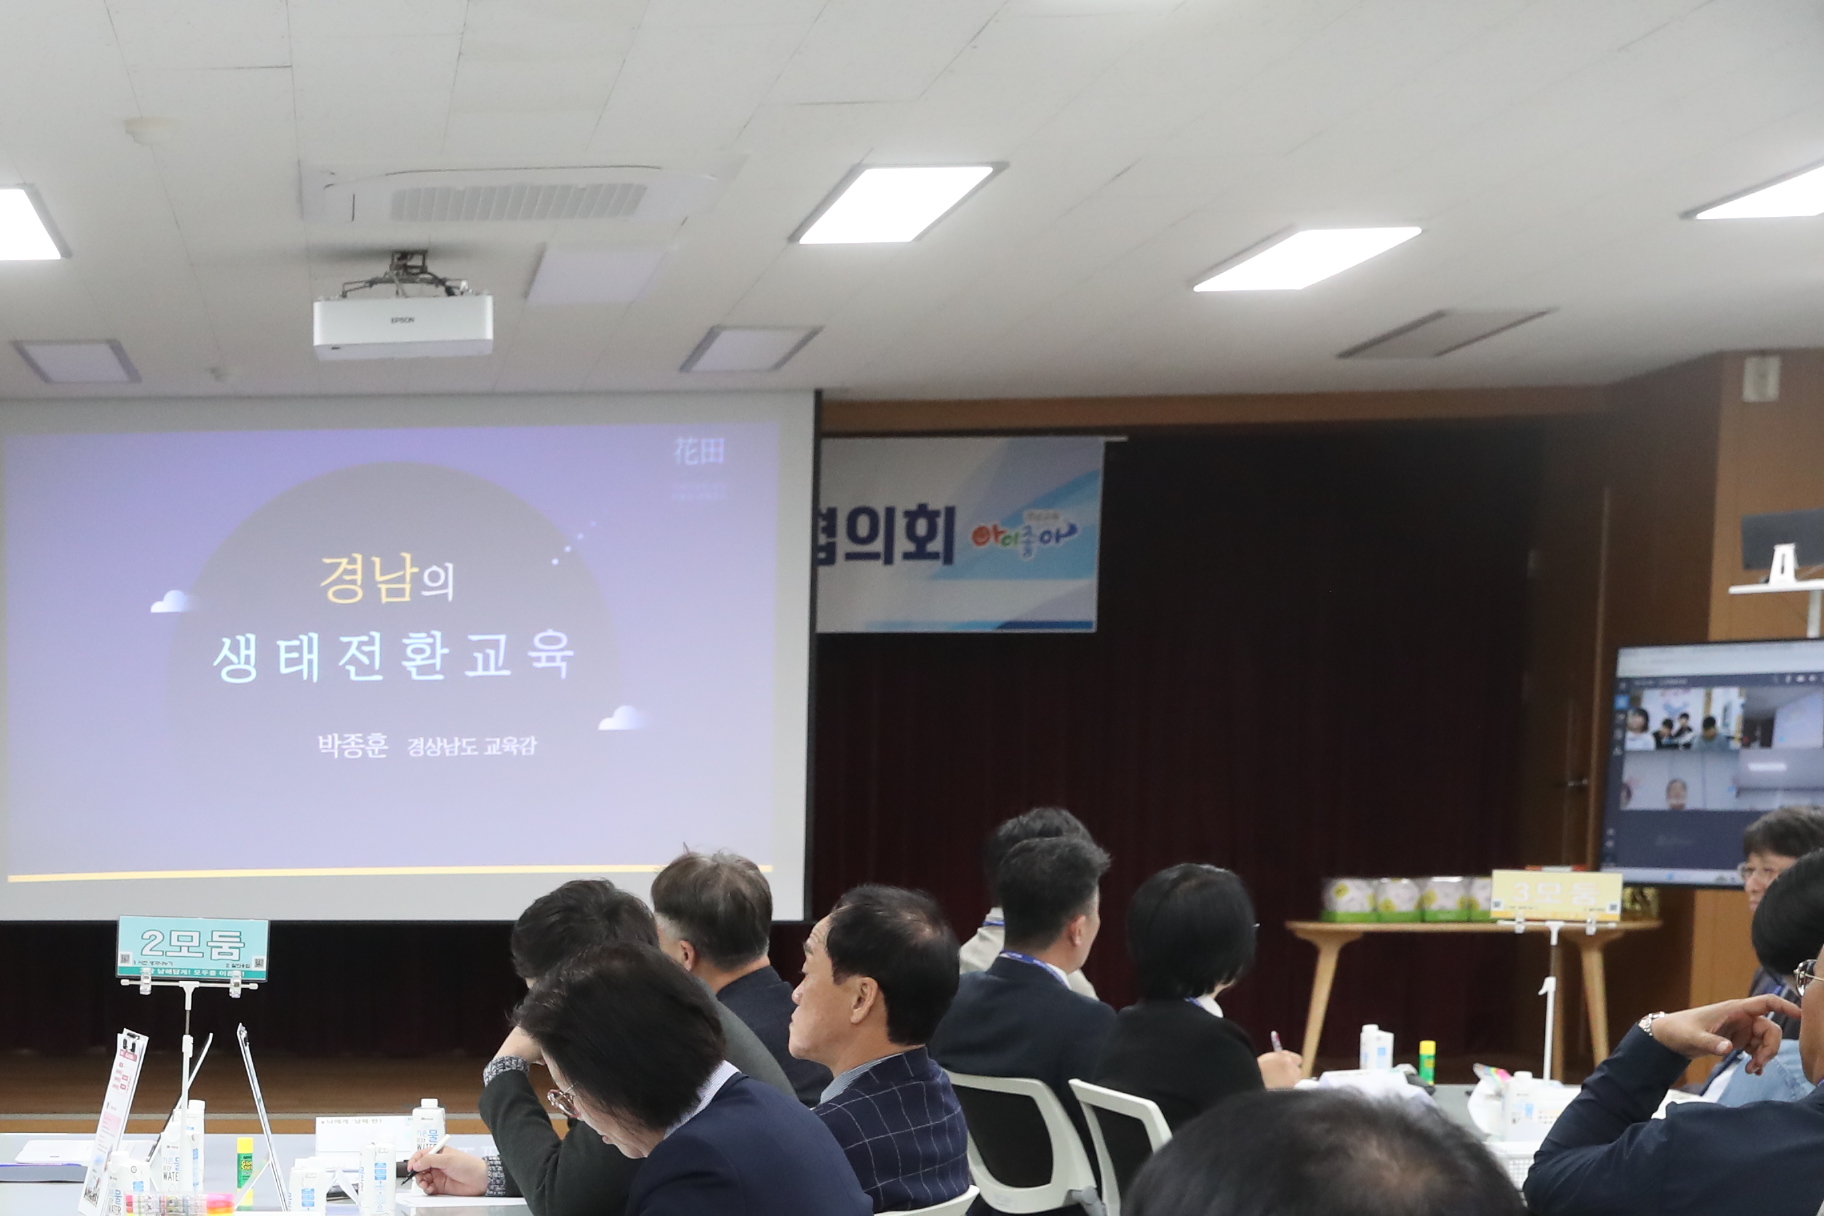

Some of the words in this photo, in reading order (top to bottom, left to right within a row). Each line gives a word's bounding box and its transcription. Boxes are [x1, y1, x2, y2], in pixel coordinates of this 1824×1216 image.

[674, 437, 725, 465] 花田
[320, 552, 455, 604] 경남의
[317, 732, 389, 759] 박종훈
[407, 736, 478, 758] 경상남도
[483, 735, 537, 757] 교육감
[1513, 882, 1600, 906] 3모둠
[141, 929, 245, 961] 2모둠
